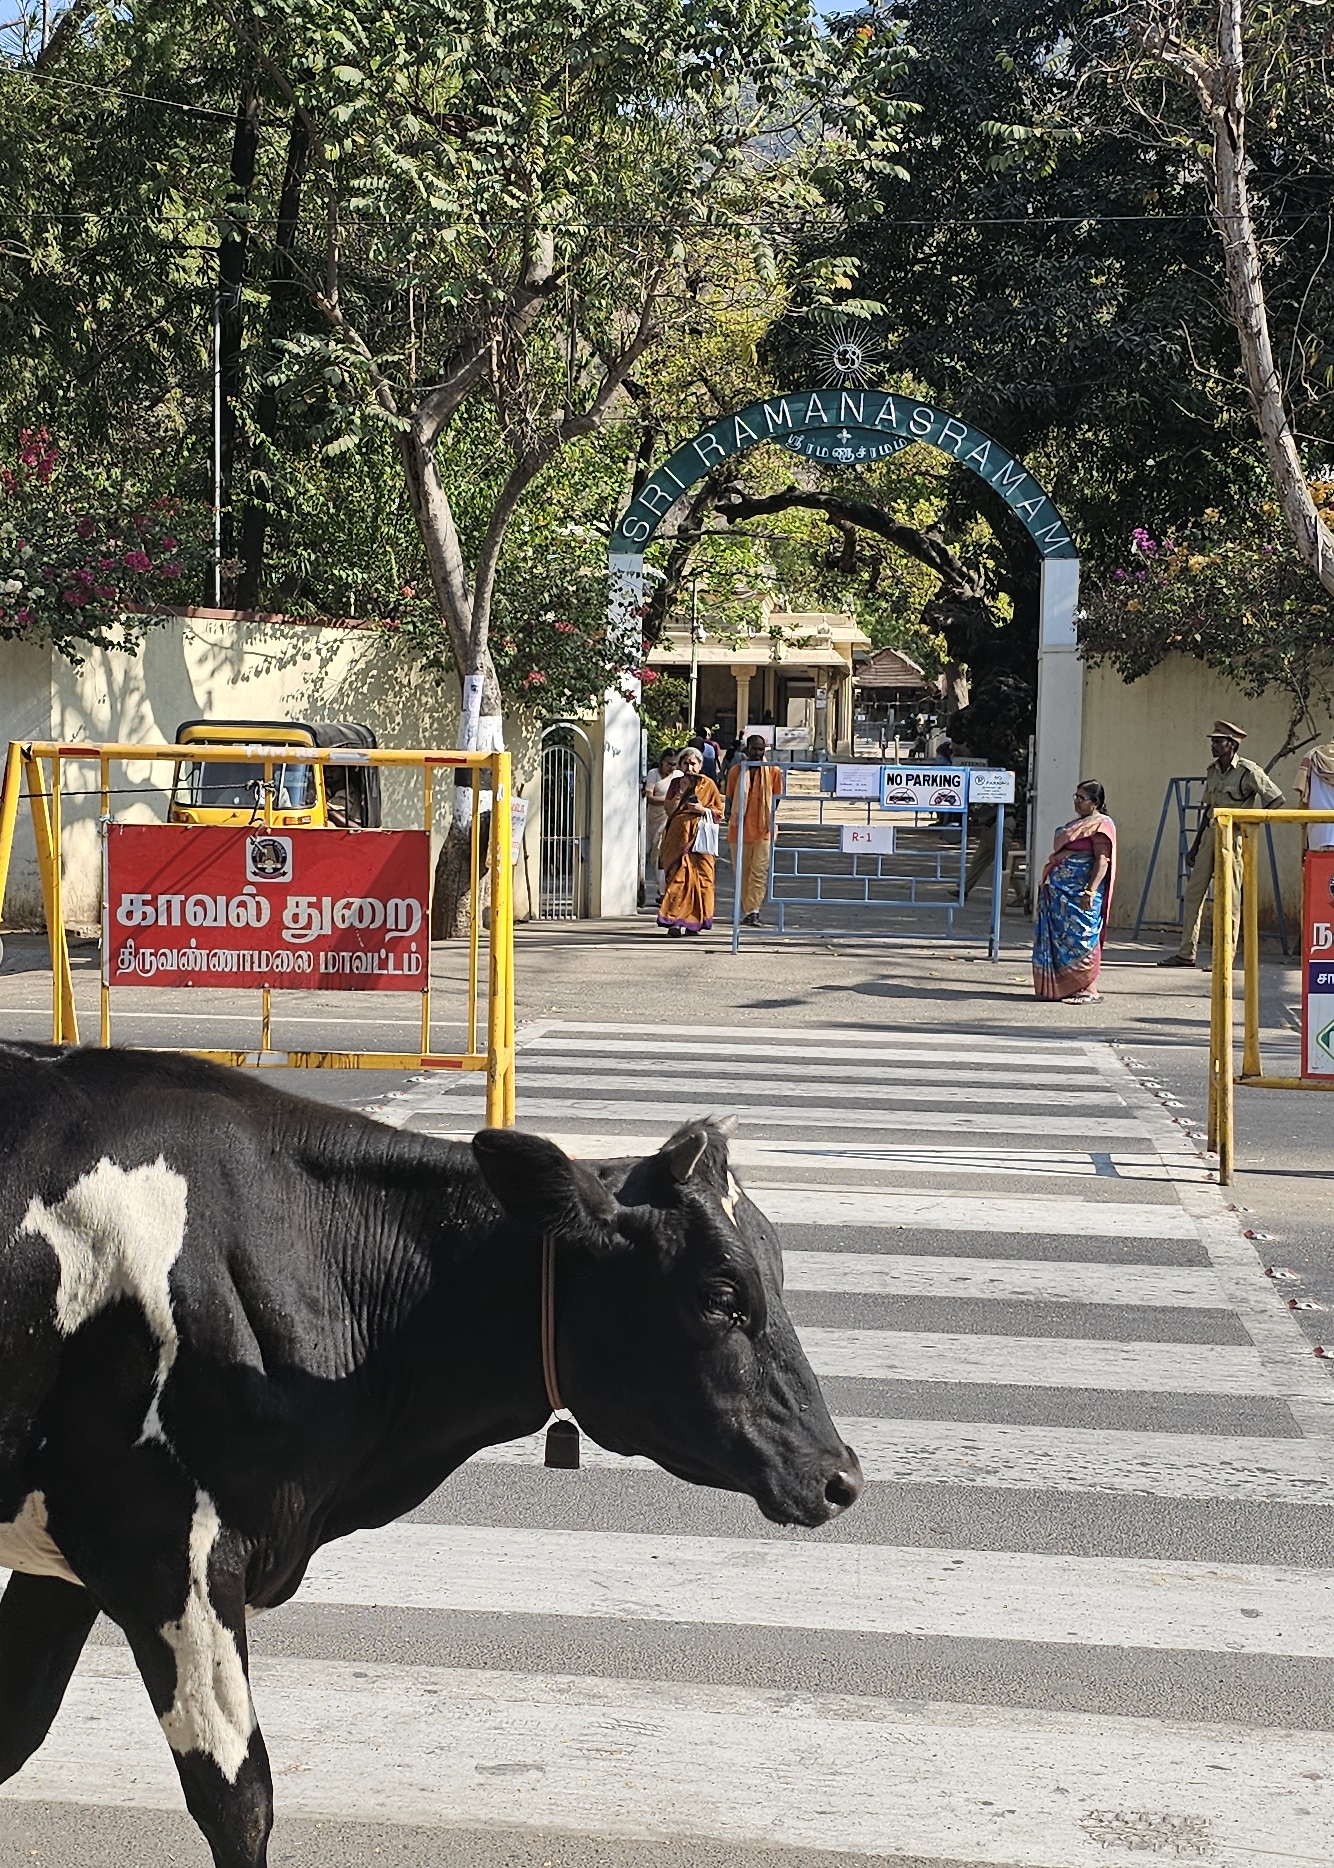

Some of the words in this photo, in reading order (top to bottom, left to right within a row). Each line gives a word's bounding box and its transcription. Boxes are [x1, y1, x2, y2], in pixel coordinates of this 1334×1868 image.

[623, 466, 685, 542] SRI
[692, 392, 1071, 554] RAMANASRAMAM
[886, 772, 903, 786] NO
[905, 773, 961, 788] PARKING
[851, 831, 873, 842] R-1
[116, 885, 271, 929] காவல்
[281, 895, 422, 943] துறை
[116, 938, 315, 977] திருவண்ணாமலை
[319, 941, 422, 975] மாவட்டம்
